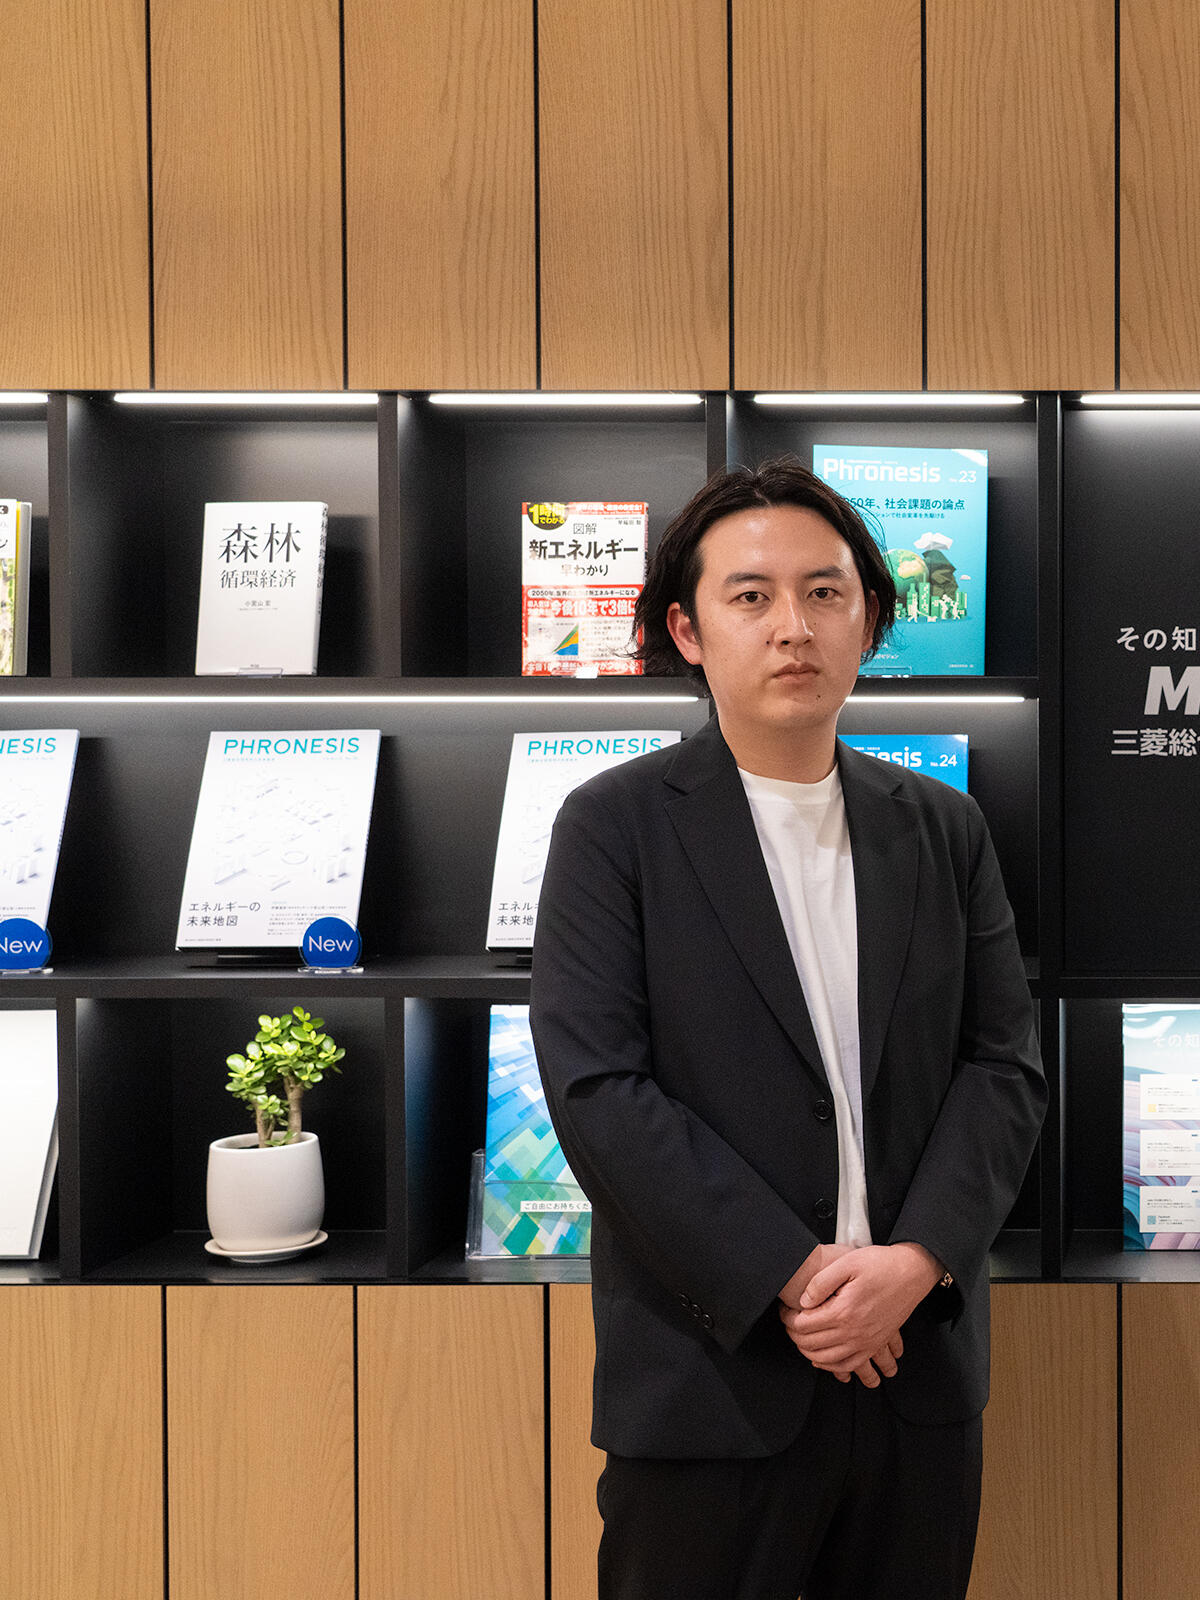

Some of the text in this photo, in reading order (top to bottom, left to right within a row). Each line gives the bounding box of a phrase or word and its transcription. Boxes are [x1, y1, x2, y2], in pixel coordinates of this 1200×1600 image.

[823, 457, 941, 483] Phronesis
[573, 523, 597, 535] 図解
[218, 522, 302, 563] 森林
[529, 538, 639, 560] 新エネルギー
[561, 564, 608, 577] 早わかり
[220, 569, 297, 589] 循環経済
[550, 599, 637, 616] 今後10年で3倍に
[223, 736, 360, 755] PHRONESIS
[527, 737, 662, 756] PHRONESIS
[188, 901, 261, 912] エネルギーの
[186, 914, 239, 927] 未来地図
[496, 914, 534, 926] 未来地
[308, 936, 354, 952] New
[524, 1202, 590, 1210] ご自由にお持ちくだ
